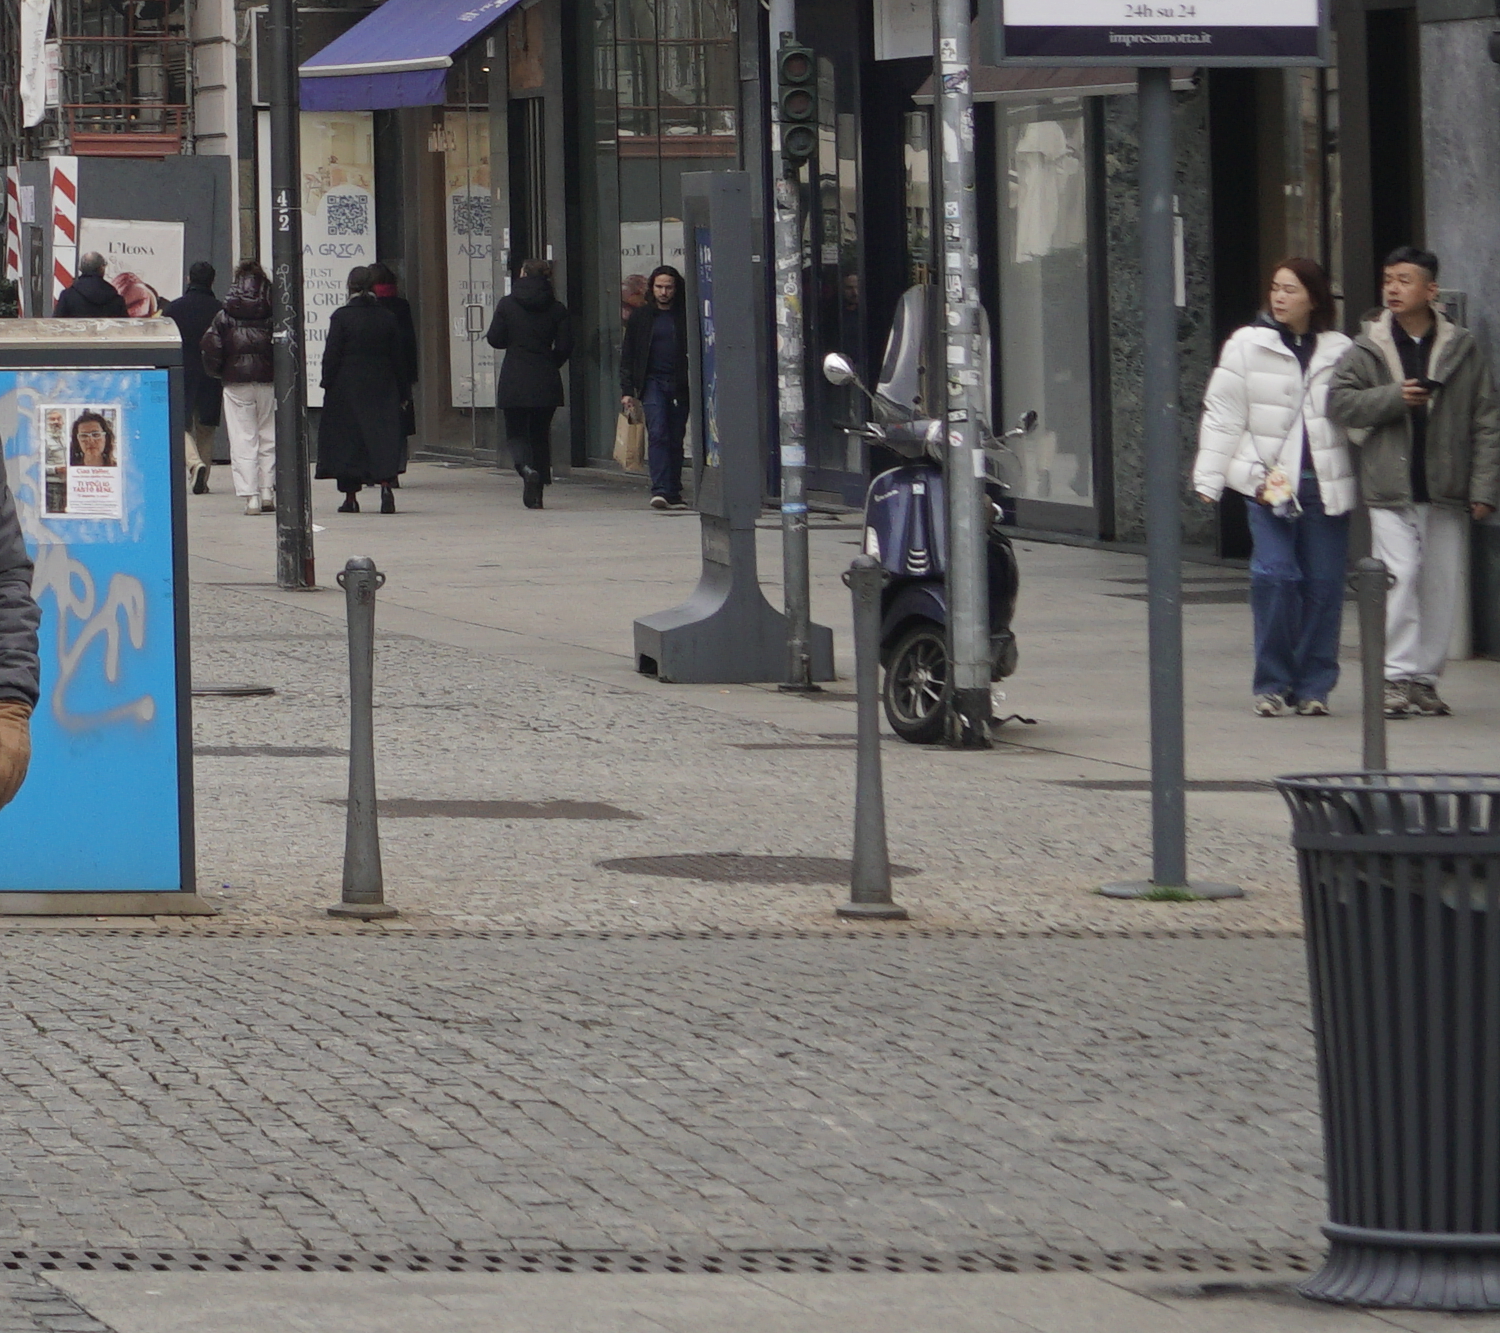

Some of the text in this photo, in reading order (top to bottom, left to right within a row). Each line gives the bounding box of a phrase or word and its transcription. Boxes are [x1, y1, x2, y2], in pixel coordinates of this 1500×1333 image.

[1124, 3, 1197, 19] 24h su 24
[1108, 31, 1213, 47] impresamotta.it
